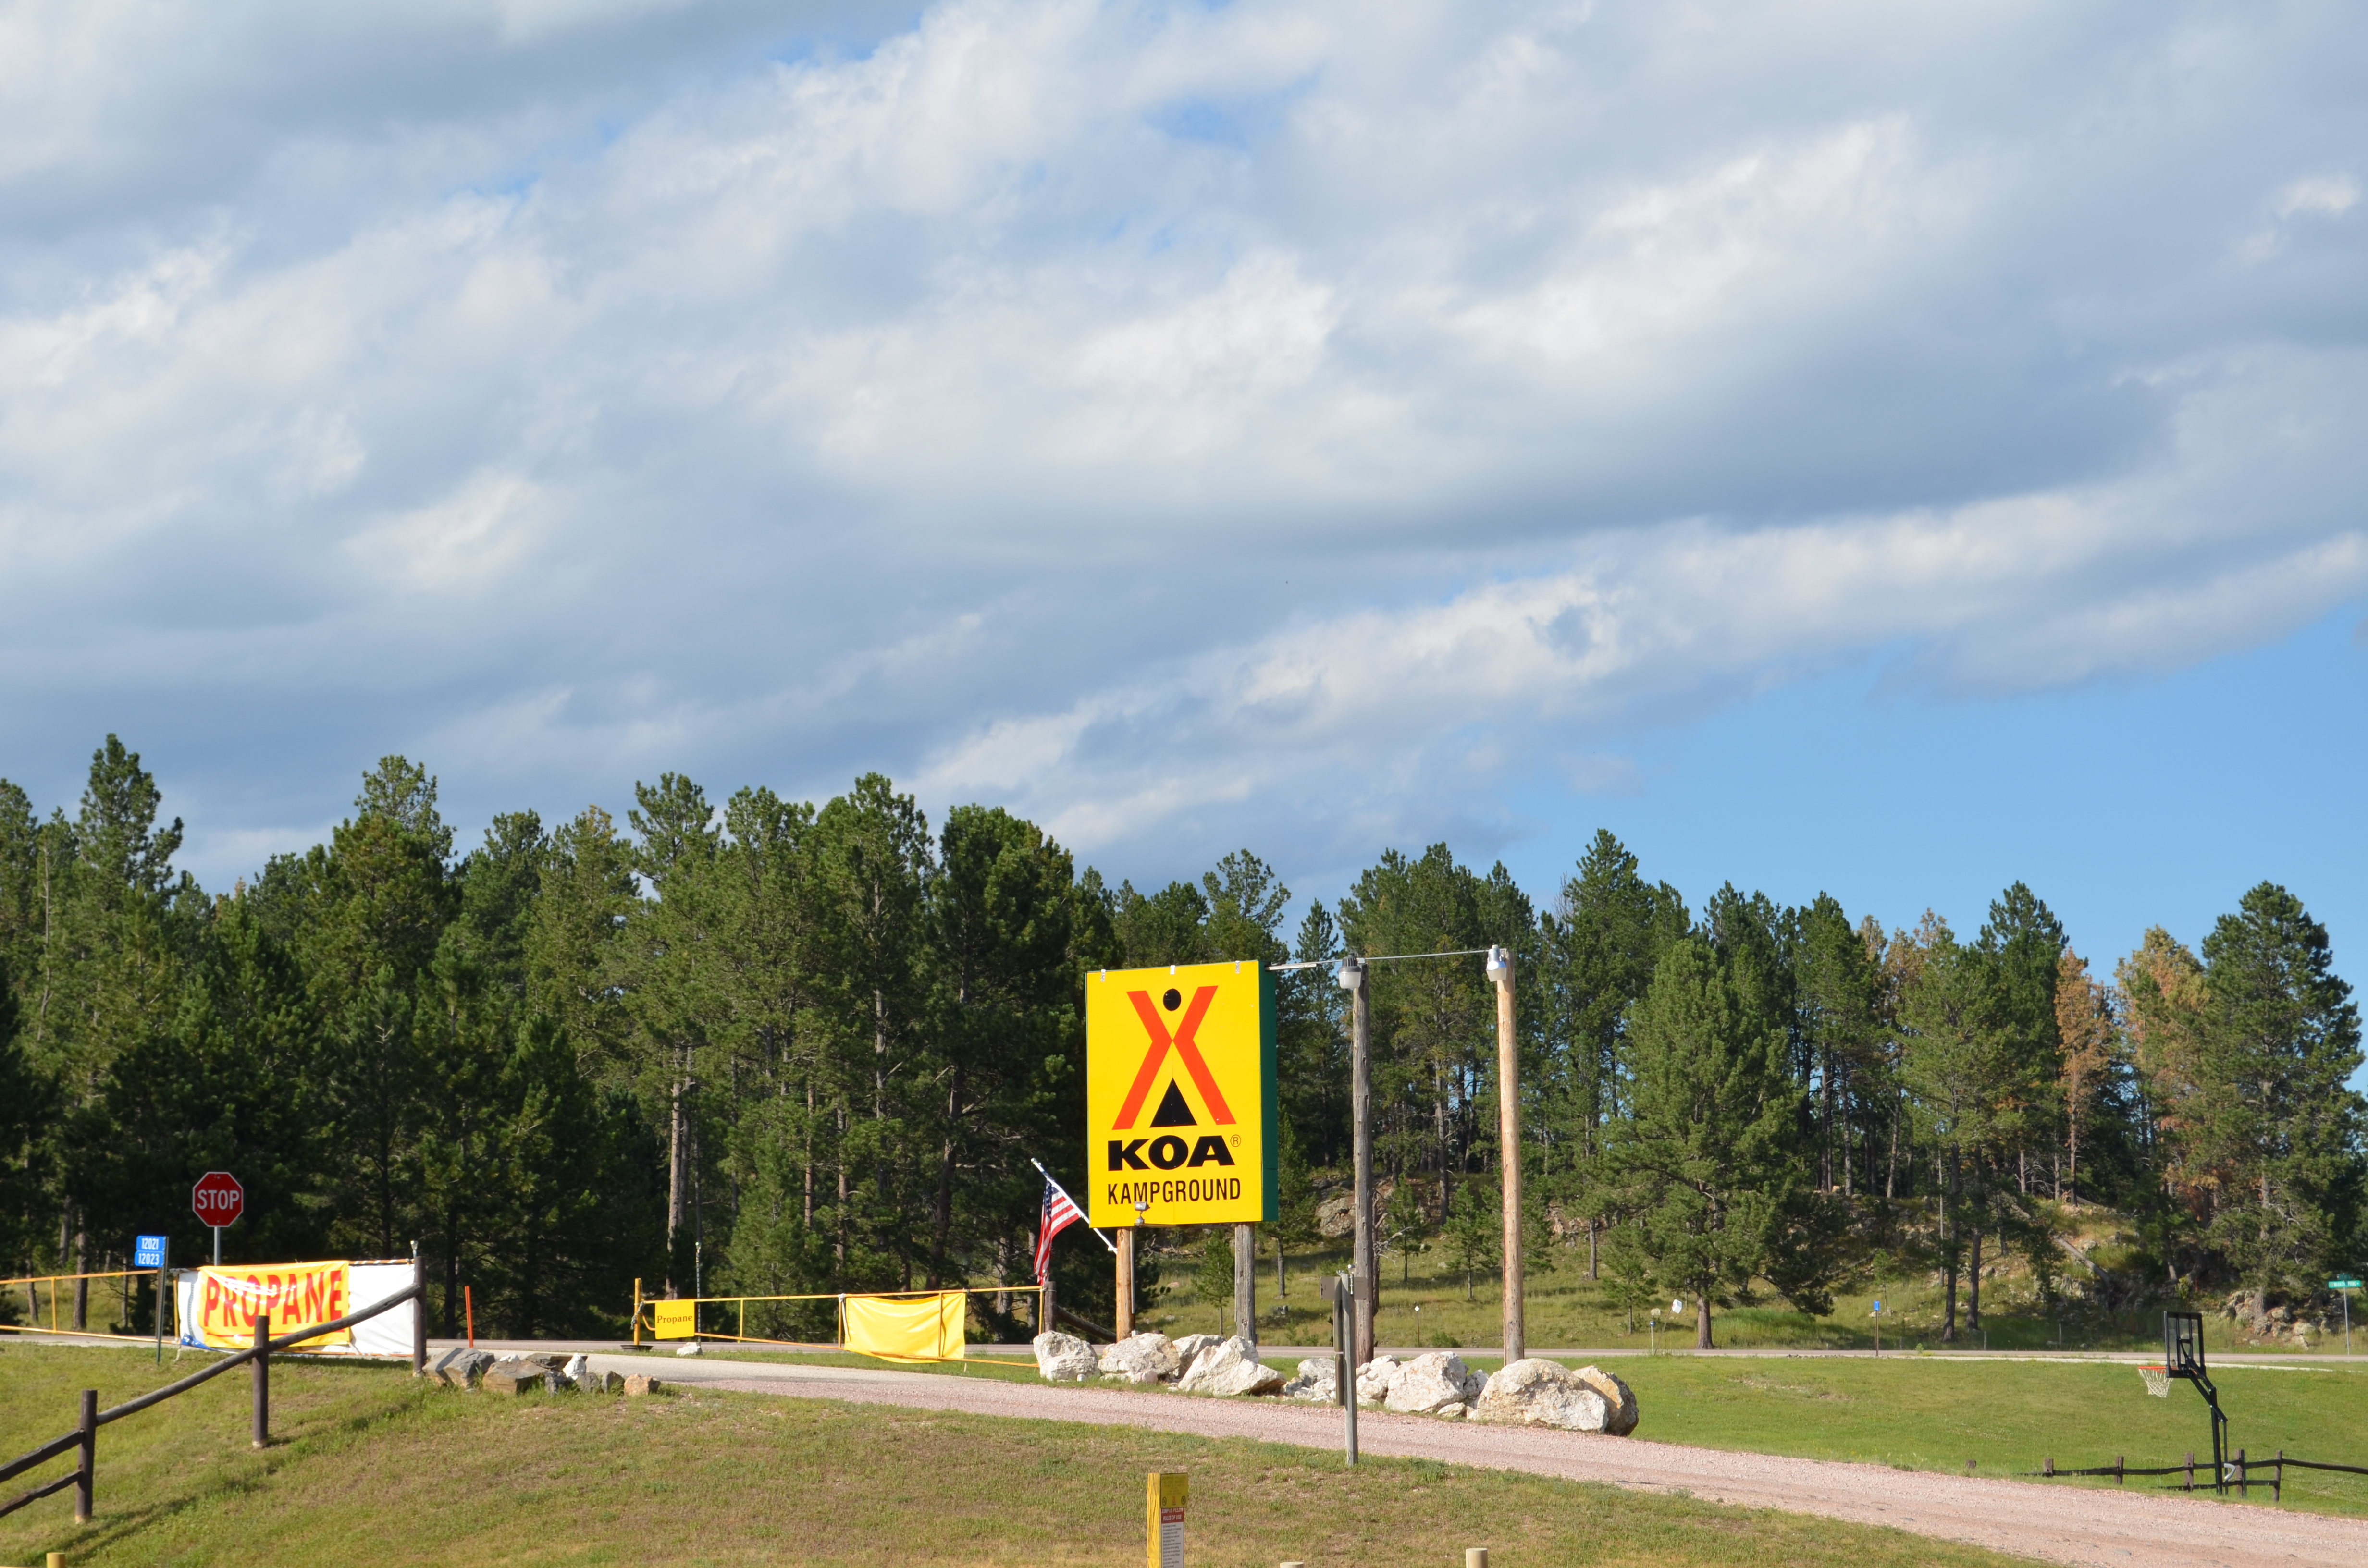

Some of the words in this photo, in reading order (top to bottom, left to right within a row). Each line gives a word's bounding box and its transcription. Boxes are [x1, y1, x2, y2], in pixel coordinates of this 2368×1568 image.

[1108, 1135, 1235, 1171] KOA
[197, 1189, 240, 1210] STOP
[1108, 1178, 1241, 1205] KAMPGROUND
[142, 1237, 159, 1250] 12021
[138, 1253, 160, 1266] 12023
[204, 1270, 342, 1328] PROPANE
[657, 1315, 693, 1325] Propane
